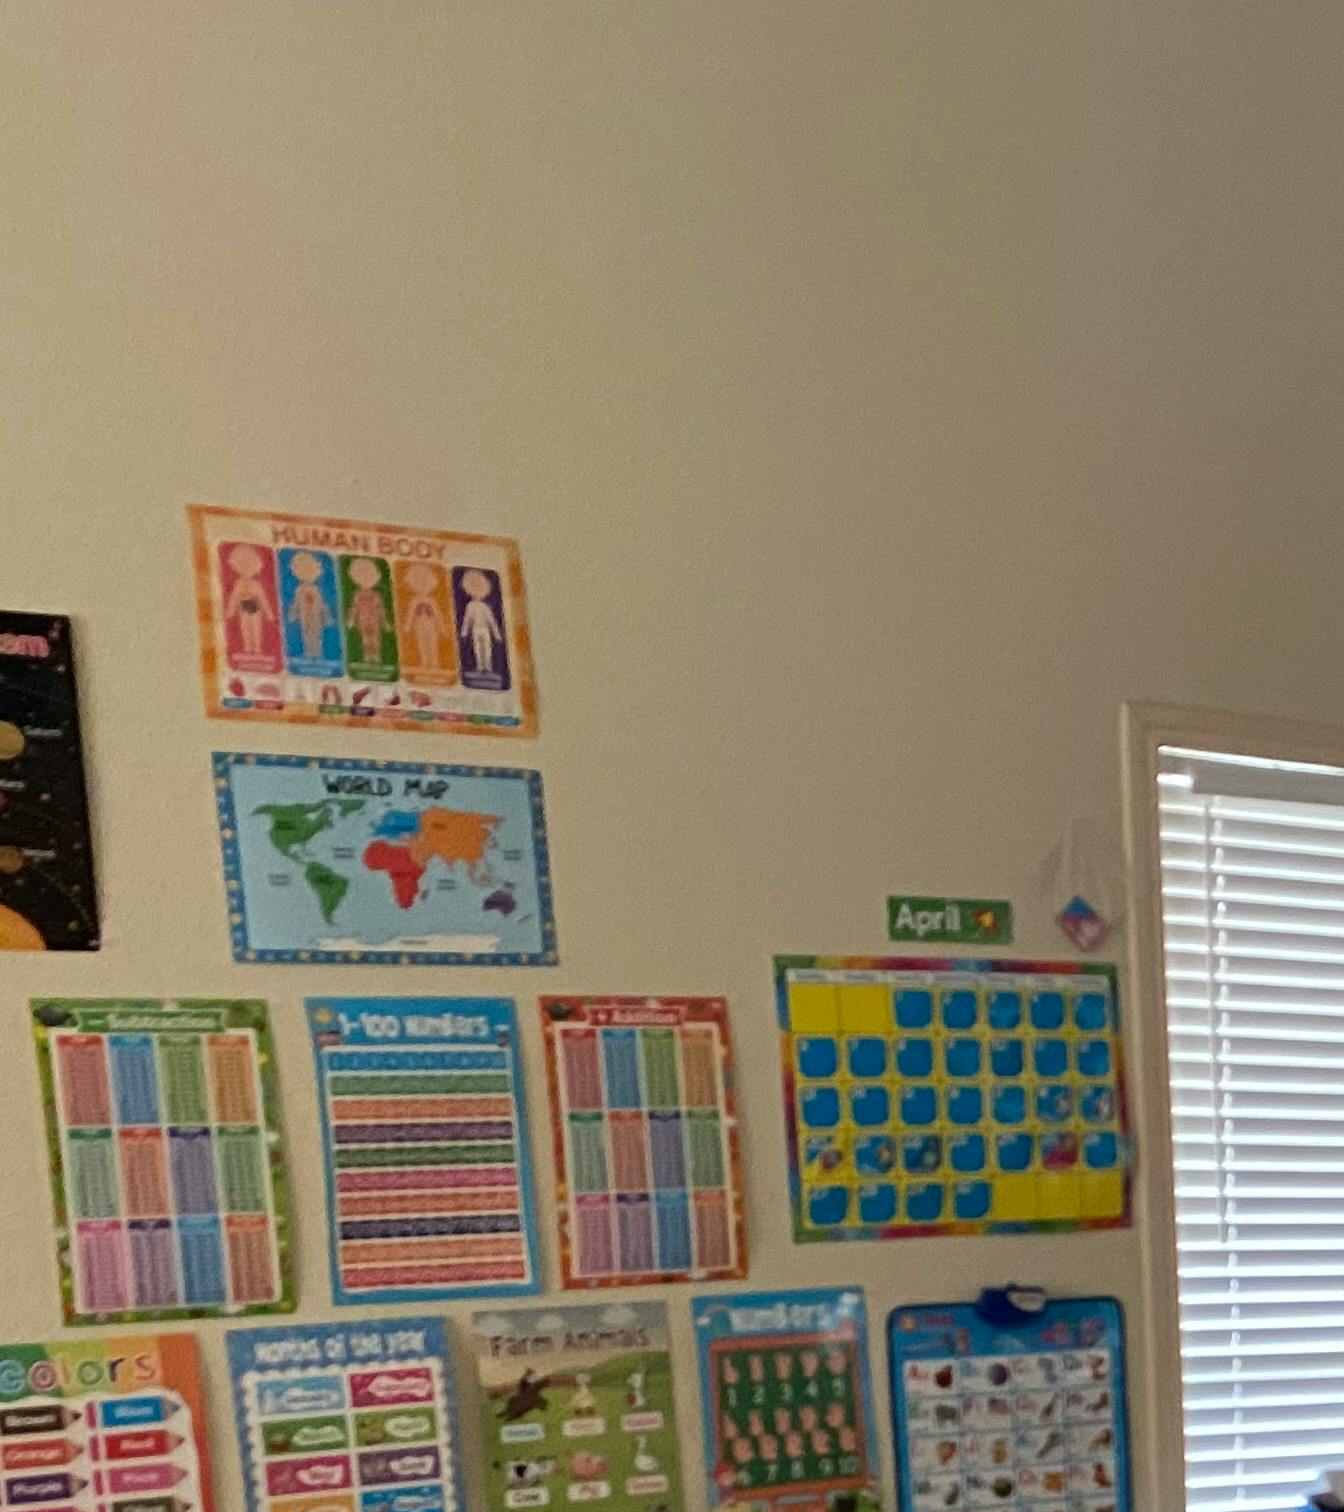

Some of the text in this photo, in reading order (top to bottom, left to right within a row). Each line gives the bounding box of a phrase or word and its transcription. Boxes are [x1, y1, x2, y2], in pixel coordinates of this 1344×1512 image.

[272, 526, 446, 559] HUMAN BODY
[322, 773, 450, 799] WORLD MAP
[895, 902, 961, 938] April
[490, 1325, 650, 1358] Farm Animals
